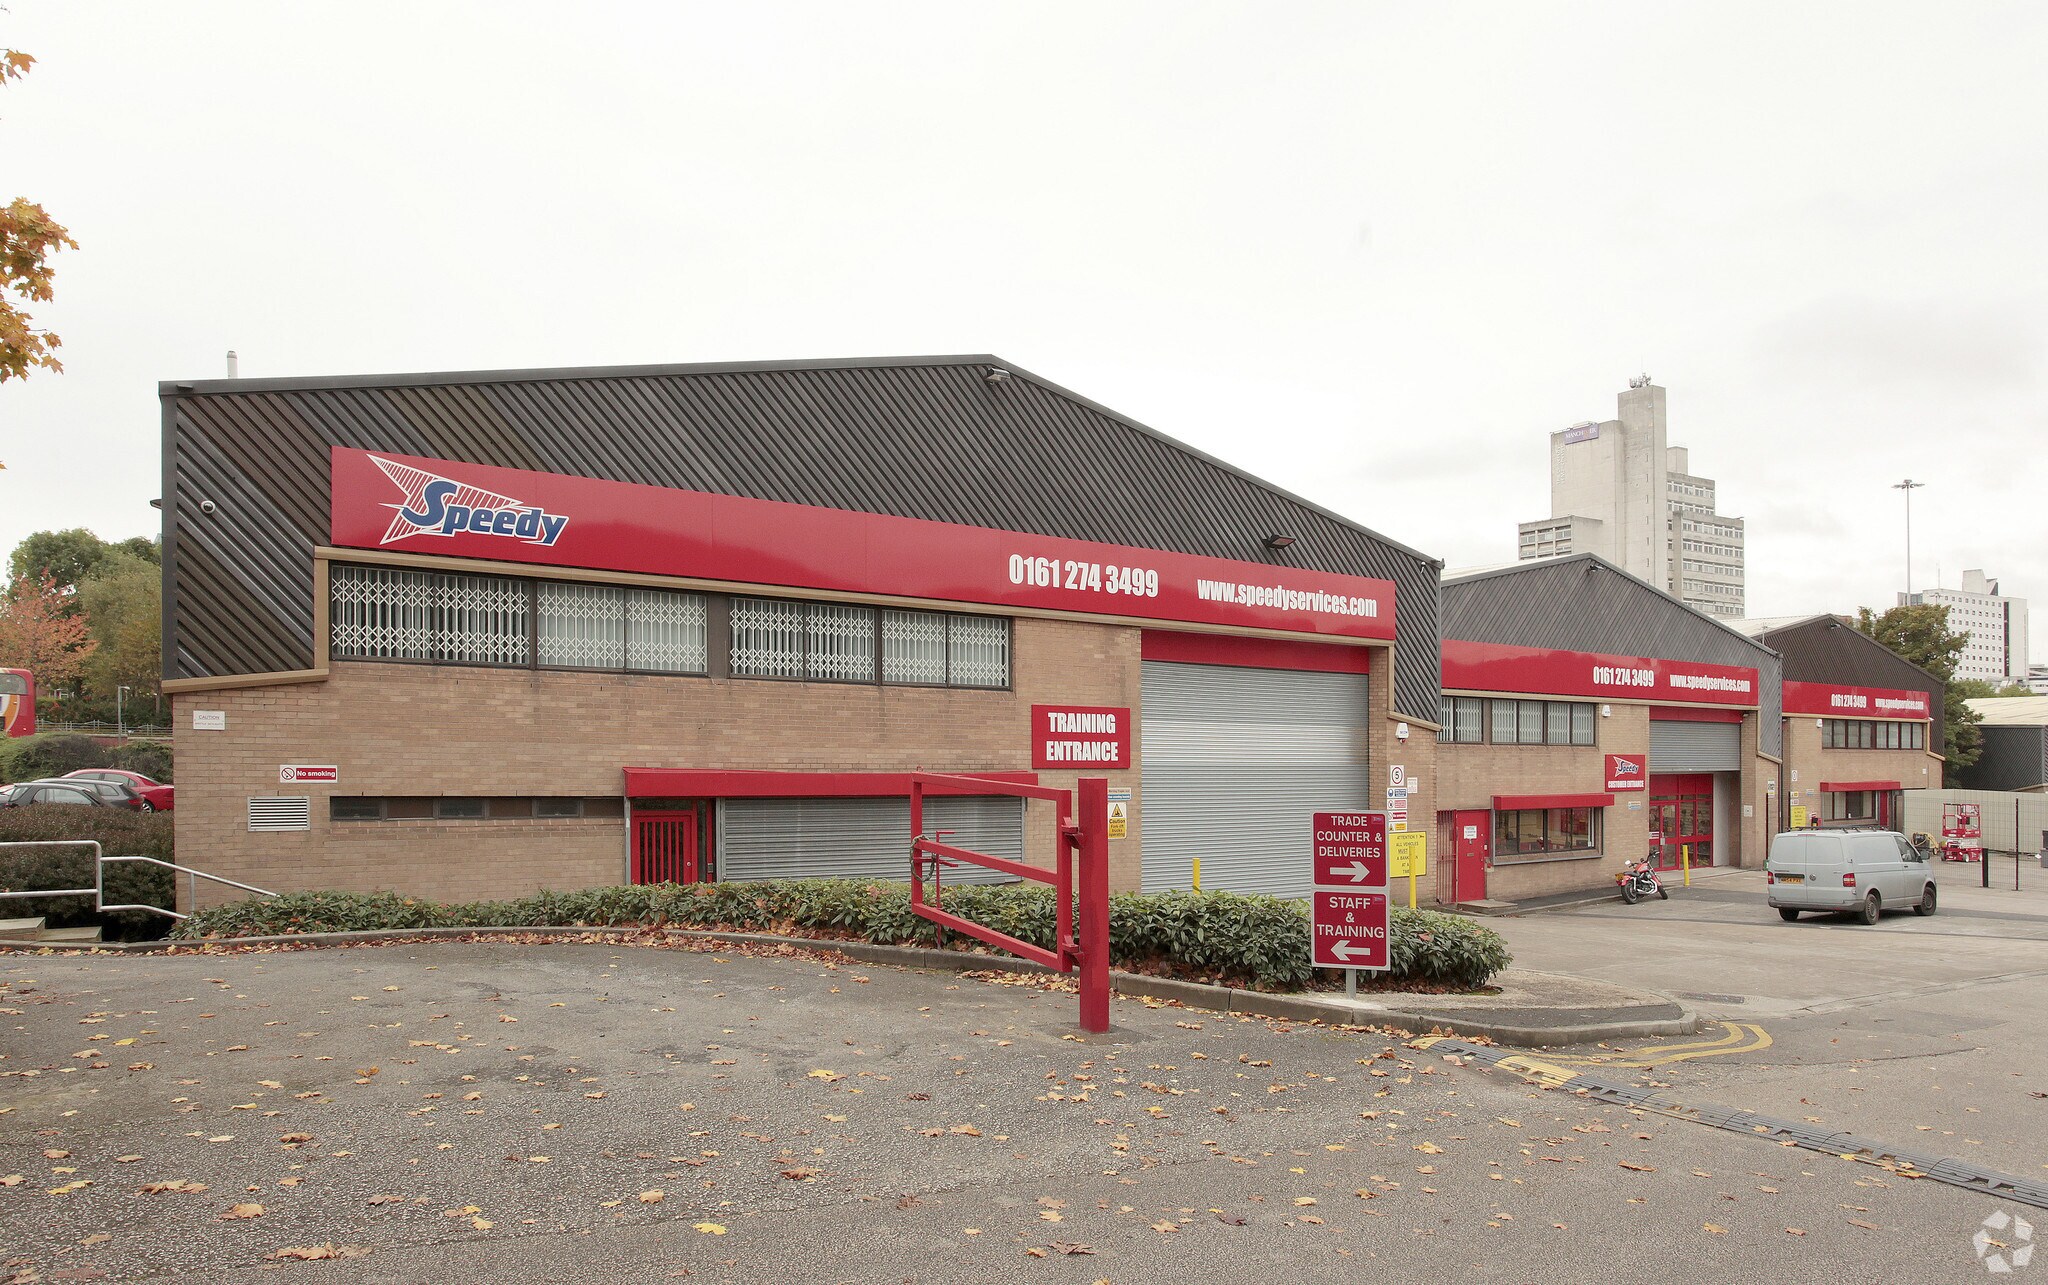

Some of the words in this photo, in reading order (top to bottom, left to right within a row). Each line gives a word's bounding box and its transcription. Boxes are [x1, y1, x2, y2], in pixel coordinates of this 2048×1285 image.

[399, 479, 568, 546] Speedy
[1009, 553, 1060, 587] 0161
[1065, 560, 1102, 592] 274
[1106, 565, 1159, 598] 3499
[1197, 577, 1378, 618] www.speedyservices.com
[1593, 665, 1614, 685] 0161
[1615, 667, 1631, 686] 274
[1631, 669, 1654, 687] 3499
[1669, 674, 1750, 693] www.speedyservices.com
[1047, 712, 1116, 734] TRAINING
[1046, 740, 1118, 762] ENTRANCE
[307, 769, 336, 778] smoking
[1395, 770, 1400, 780] 5
[1331, 815, 1368, 826] TRADE
[1317, 830, 1370, 842] COUNTER
[1374, 832, 1383, 843] &
[1319, 846, 1381, 858] DELIVERIES
[1329, 896, 1371, 910] STAFF
[1345, 911, 1355, 923] &
[1317, 923, 1385, 939] TRAINING
